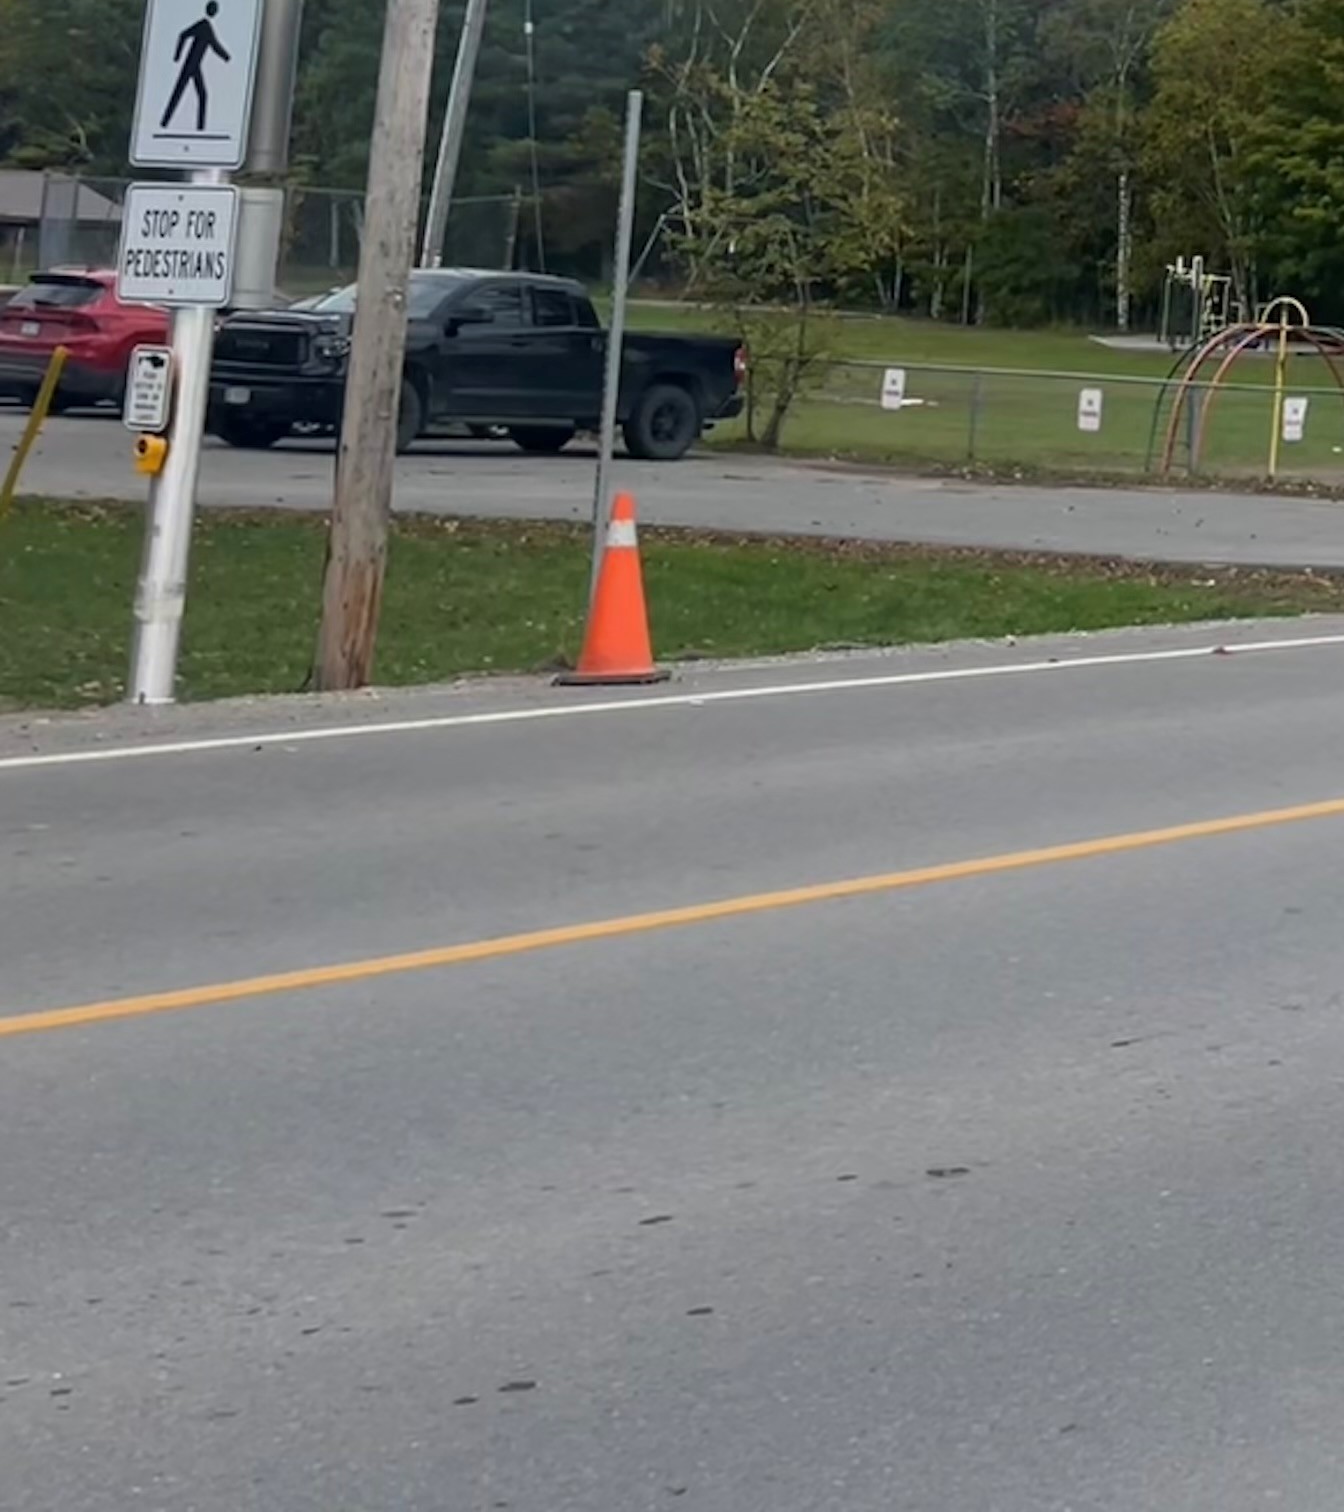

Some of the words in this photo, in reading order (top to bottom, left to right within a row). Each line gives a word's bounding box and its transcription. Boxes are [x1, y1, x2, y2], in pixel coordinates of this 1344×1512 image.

[141, 209, 180, 238] STOP
[186, 210, 216, 239] FOR
[124, 249, 225, 280] PEDESTRIANS
